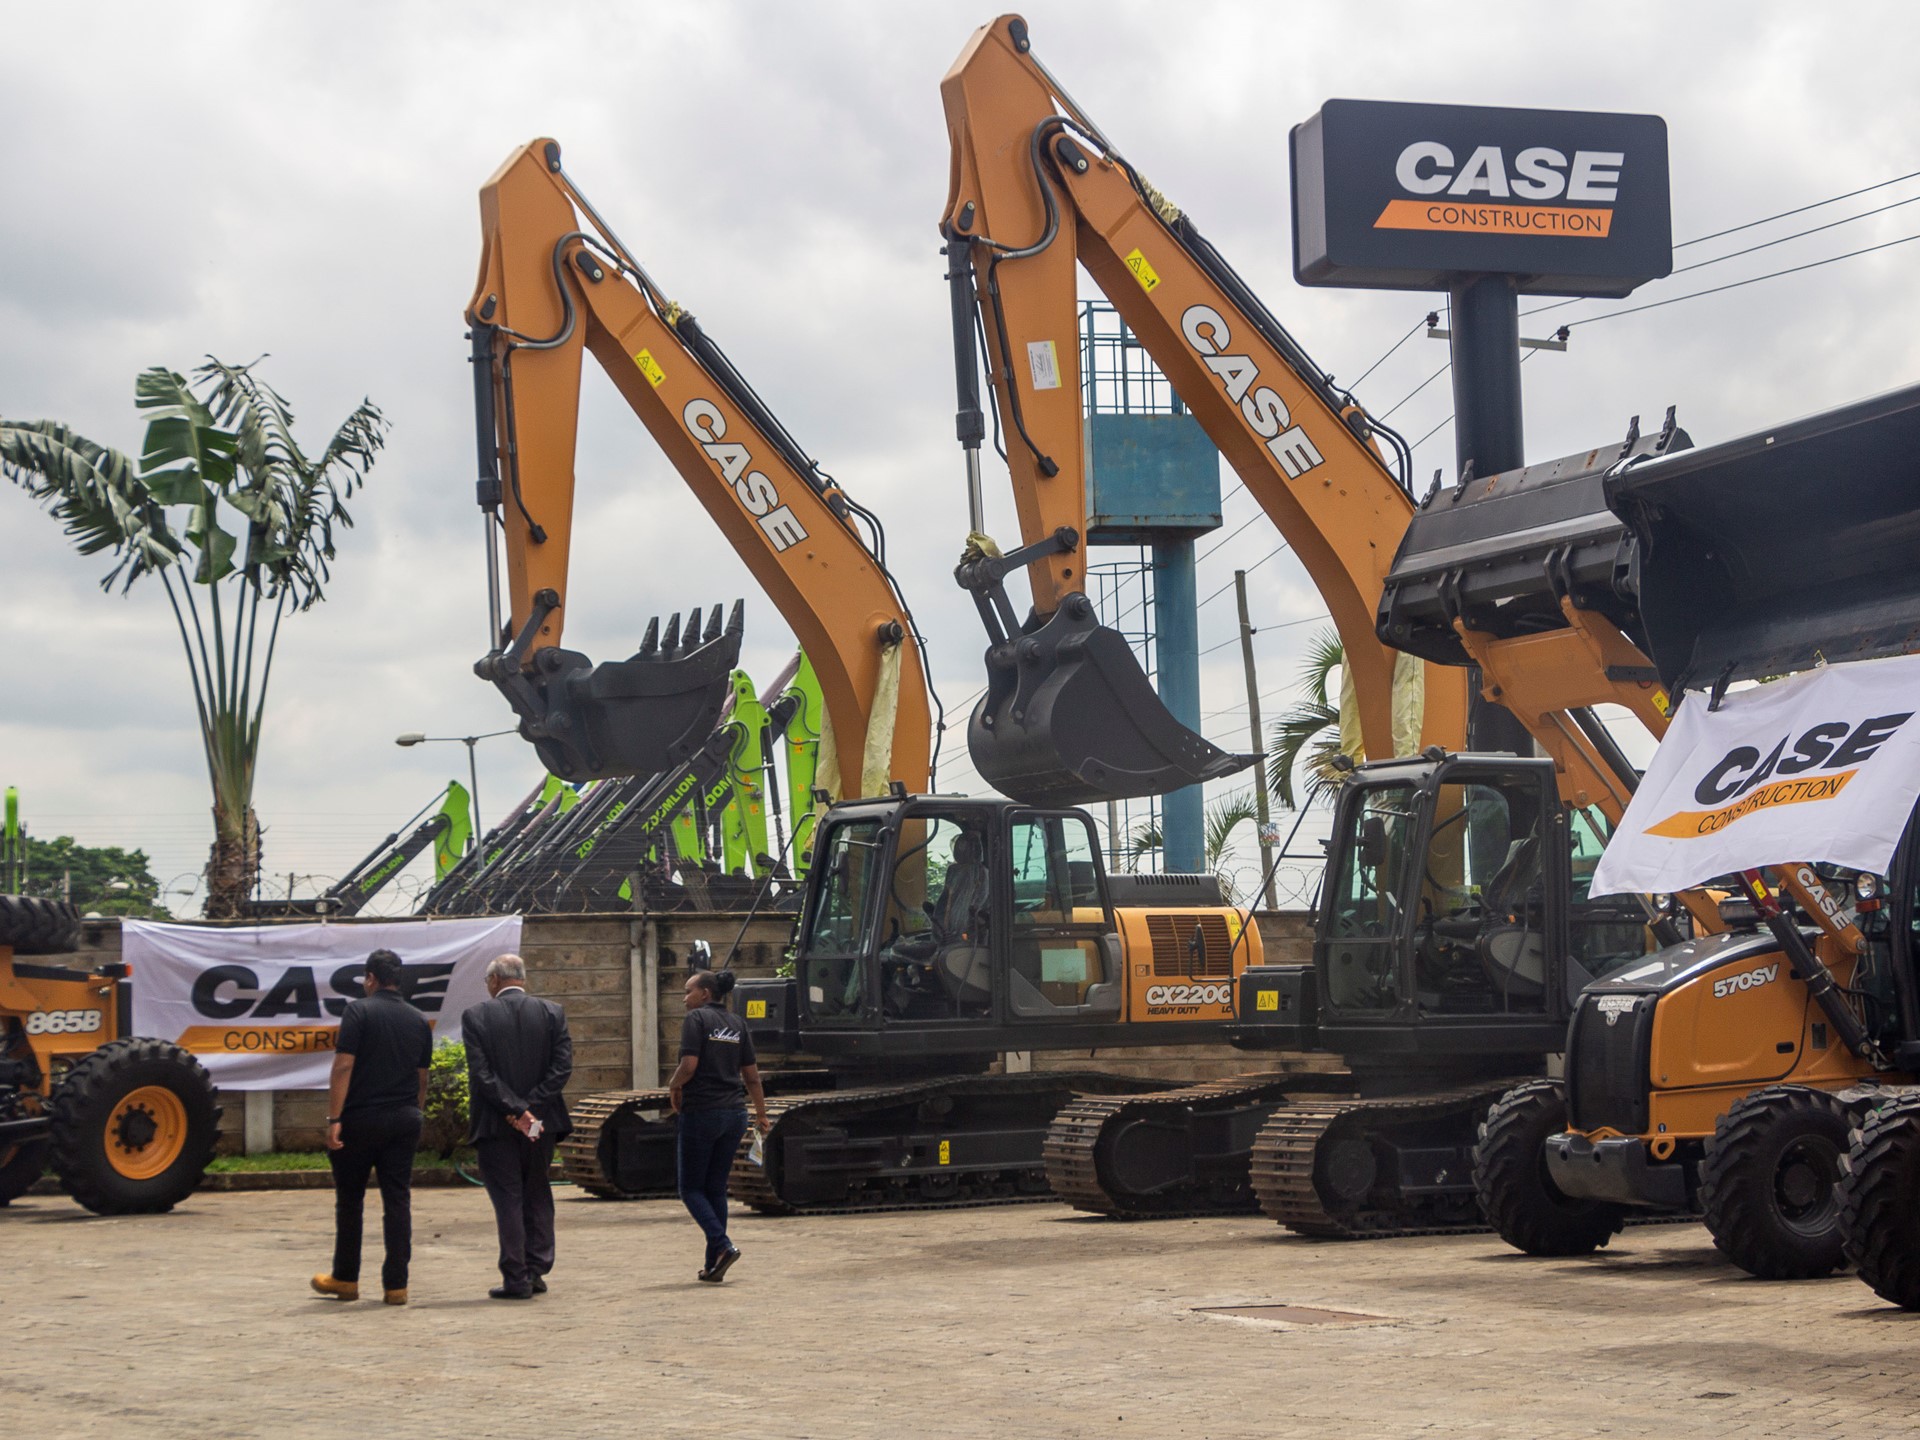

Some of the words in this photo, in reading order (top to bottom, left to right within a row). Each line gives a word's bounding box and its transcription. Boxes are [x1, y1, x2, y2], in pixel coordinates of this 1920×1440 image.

[1396, 141, 1624, 201] CASE
[1427, 206, 1602, 231] CONSTRUCTION
[1180, 304, 1325, 480] CASE
[683, 398, 809, 553] CASE
[1694, 711, 1916, 805] CASE
[641, 773, 698, 834] ZOOMLION
[1697, 775, 1846, 834] CONSTRUCTION
[1796, 867, 1850, 931] CASE
[191, 961, 456, 1019] CASE
[1713, 963, 1779, 998] 570SV
[26, 1009, 102, 1035] 865B
[1147, 1006, 1177, 1015] HEAVY
[1177, 1006, 1200, 1014] DUTY
